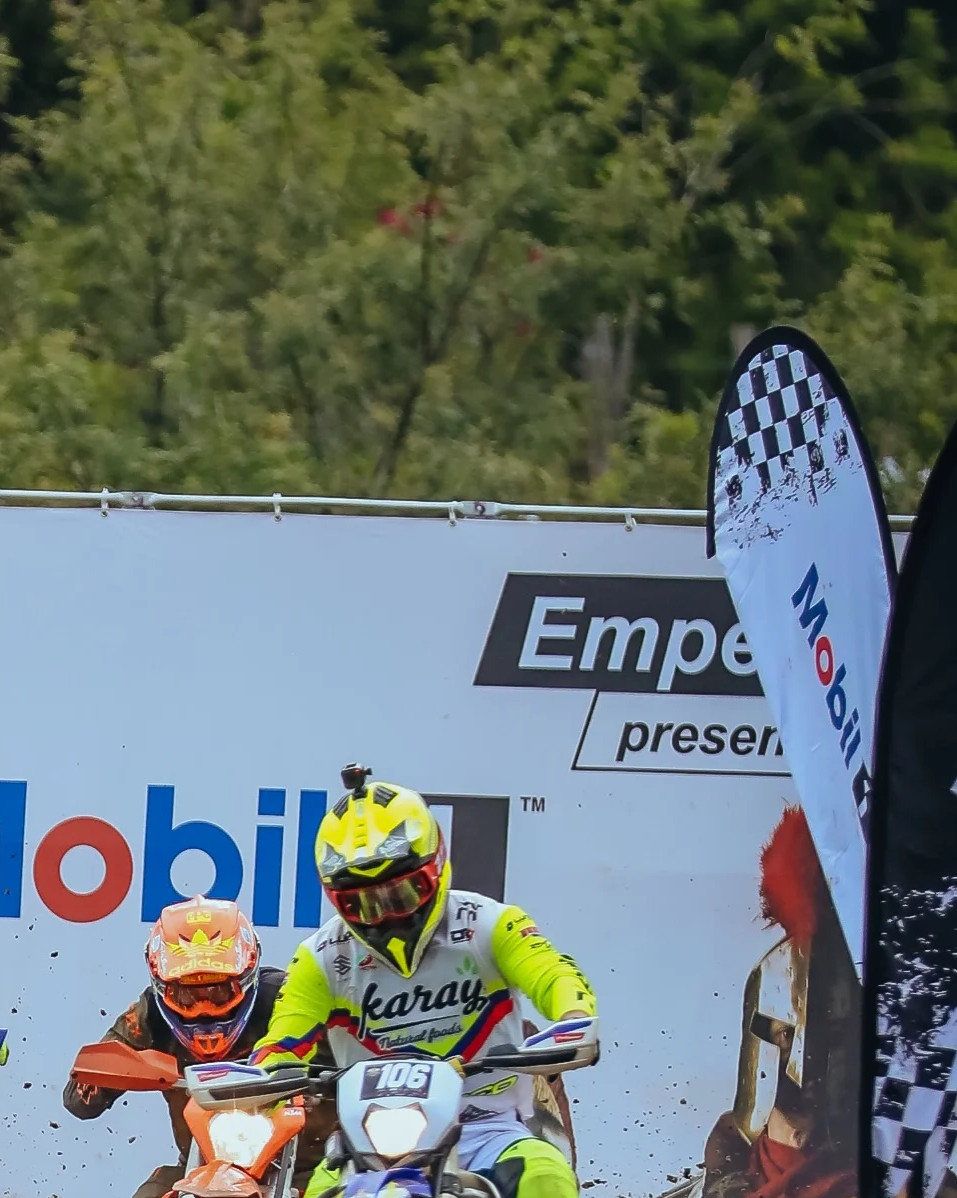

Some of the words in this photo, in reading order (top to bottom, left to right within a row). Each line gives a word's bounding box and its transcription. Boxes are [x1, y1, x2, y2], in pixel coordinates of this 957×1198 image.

[791, 562, 862, 771] Mobil
[168, 957, 236, 977] adidas
[357, 978, 489, 1041] karay
[378, 1030, 426, 1050] Natural
[426, 1023, 463, 1044] foods
[376, 1062, 431, 1090] 106
